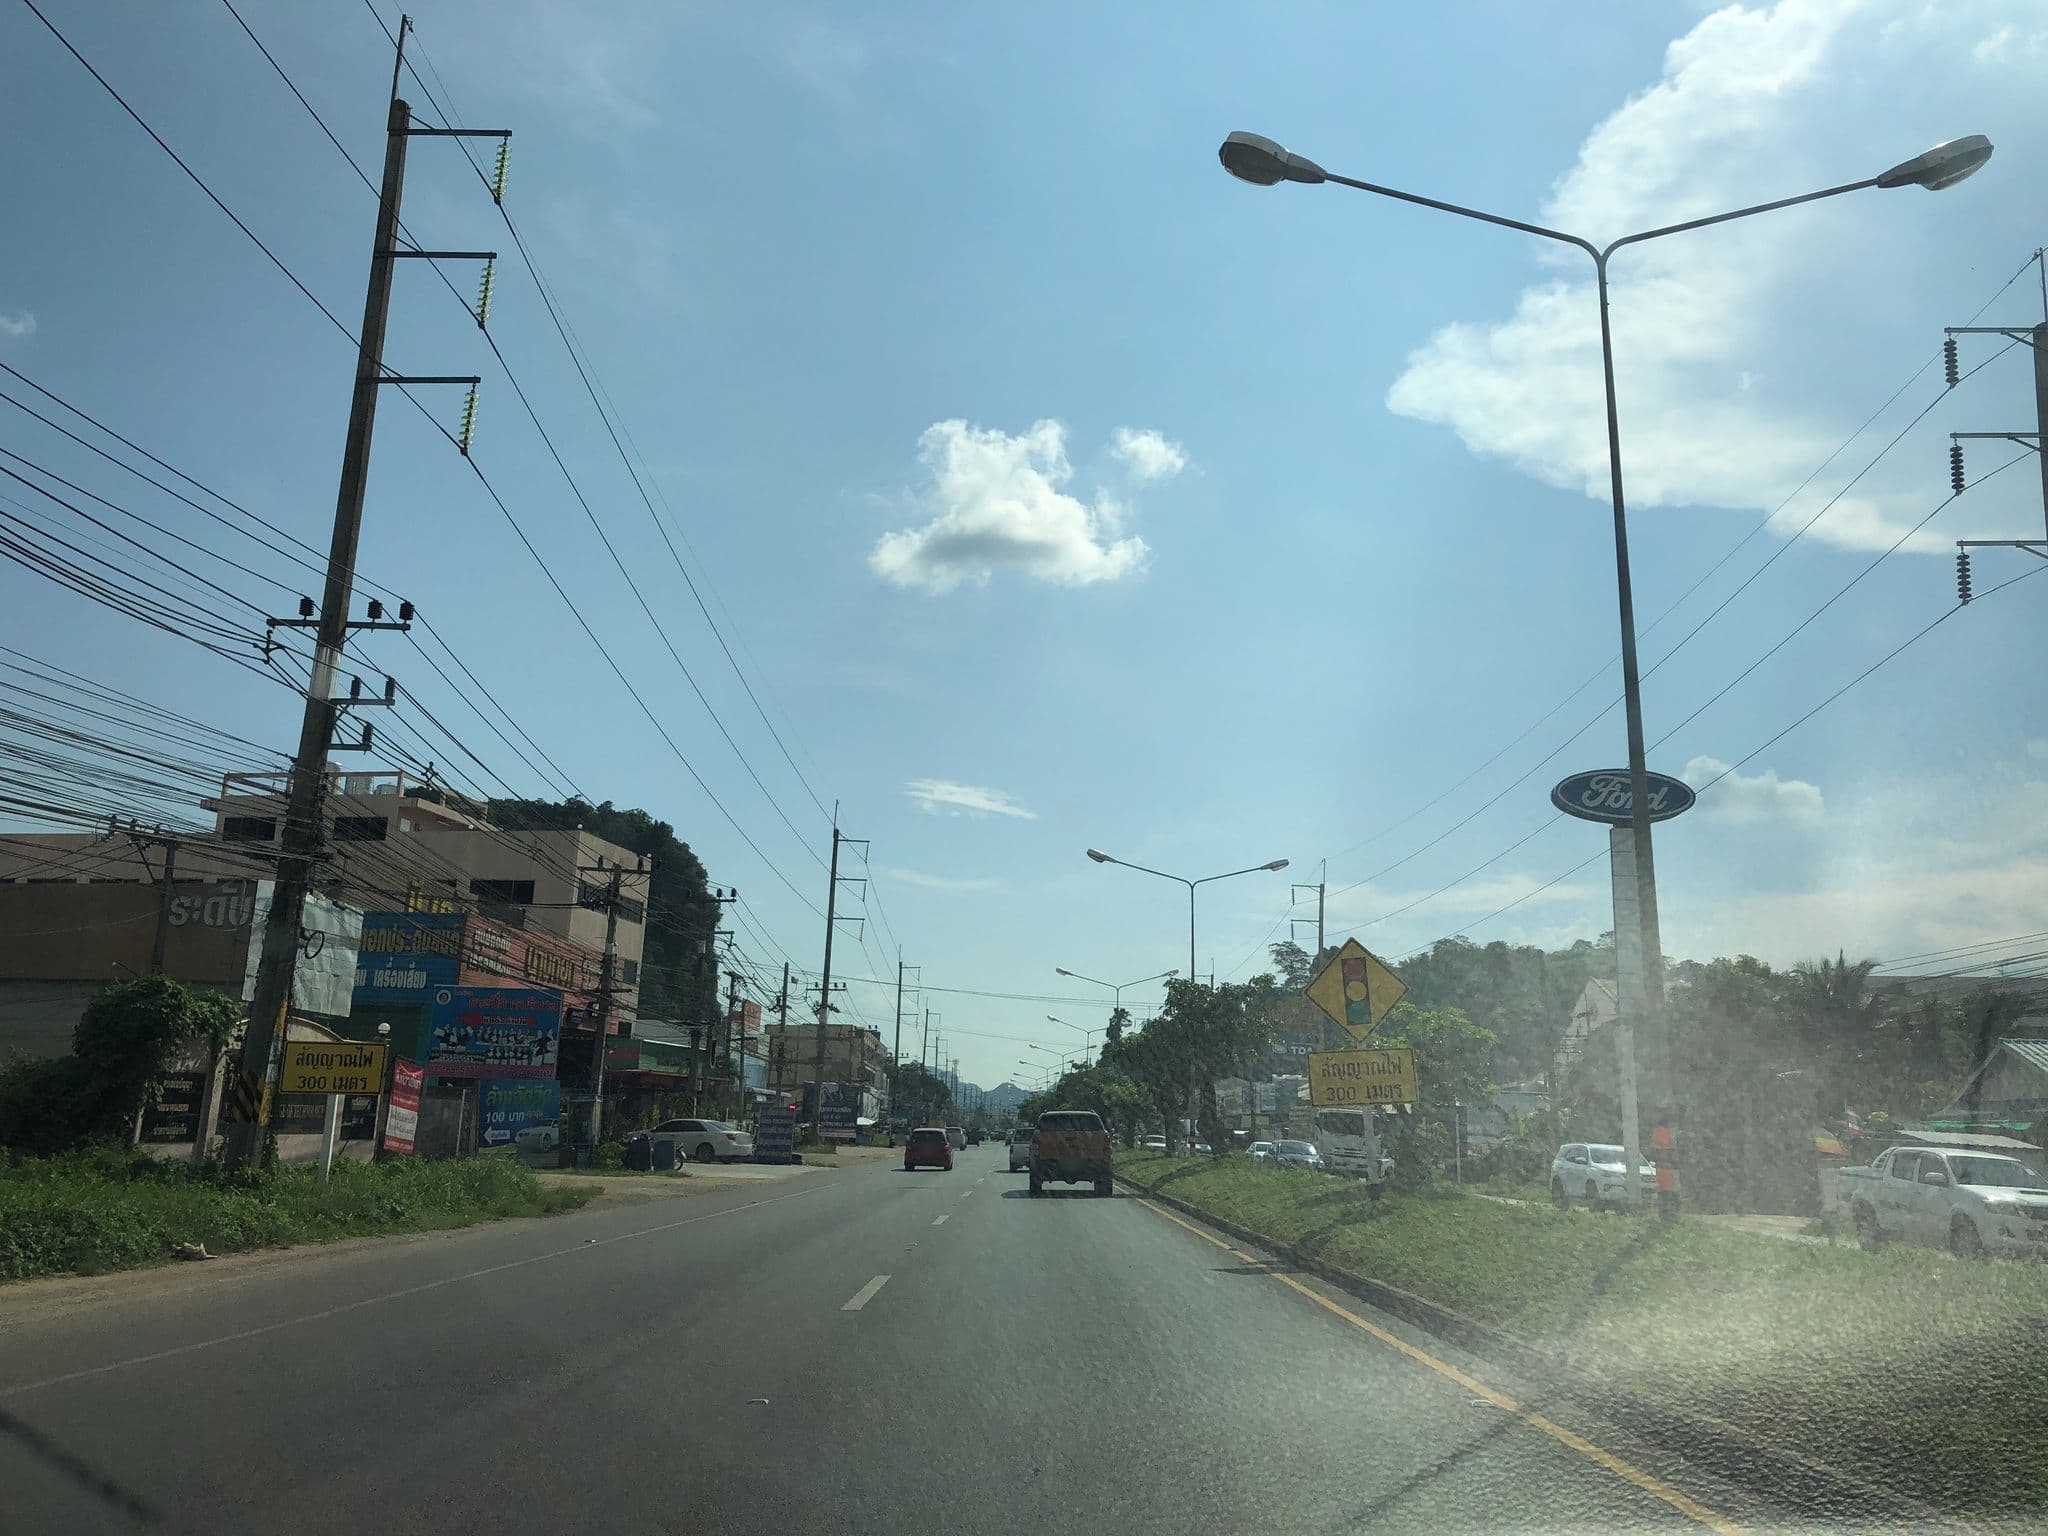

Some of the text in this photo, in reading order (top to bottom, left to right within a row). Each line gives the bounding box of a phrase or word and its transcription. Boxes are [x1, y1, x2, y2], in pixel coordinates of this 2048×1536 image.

[295, 1046, 374, 1070] สัญญาณไฟ
[1321, 1053, 1402, 1081] สัญญาณไฟ
[297, 1075, 368, 1091] 300 เมตร
[1326, 1083, 1402, 1102] 300 เมตร
[485, 1111, 505, 1124] 100
